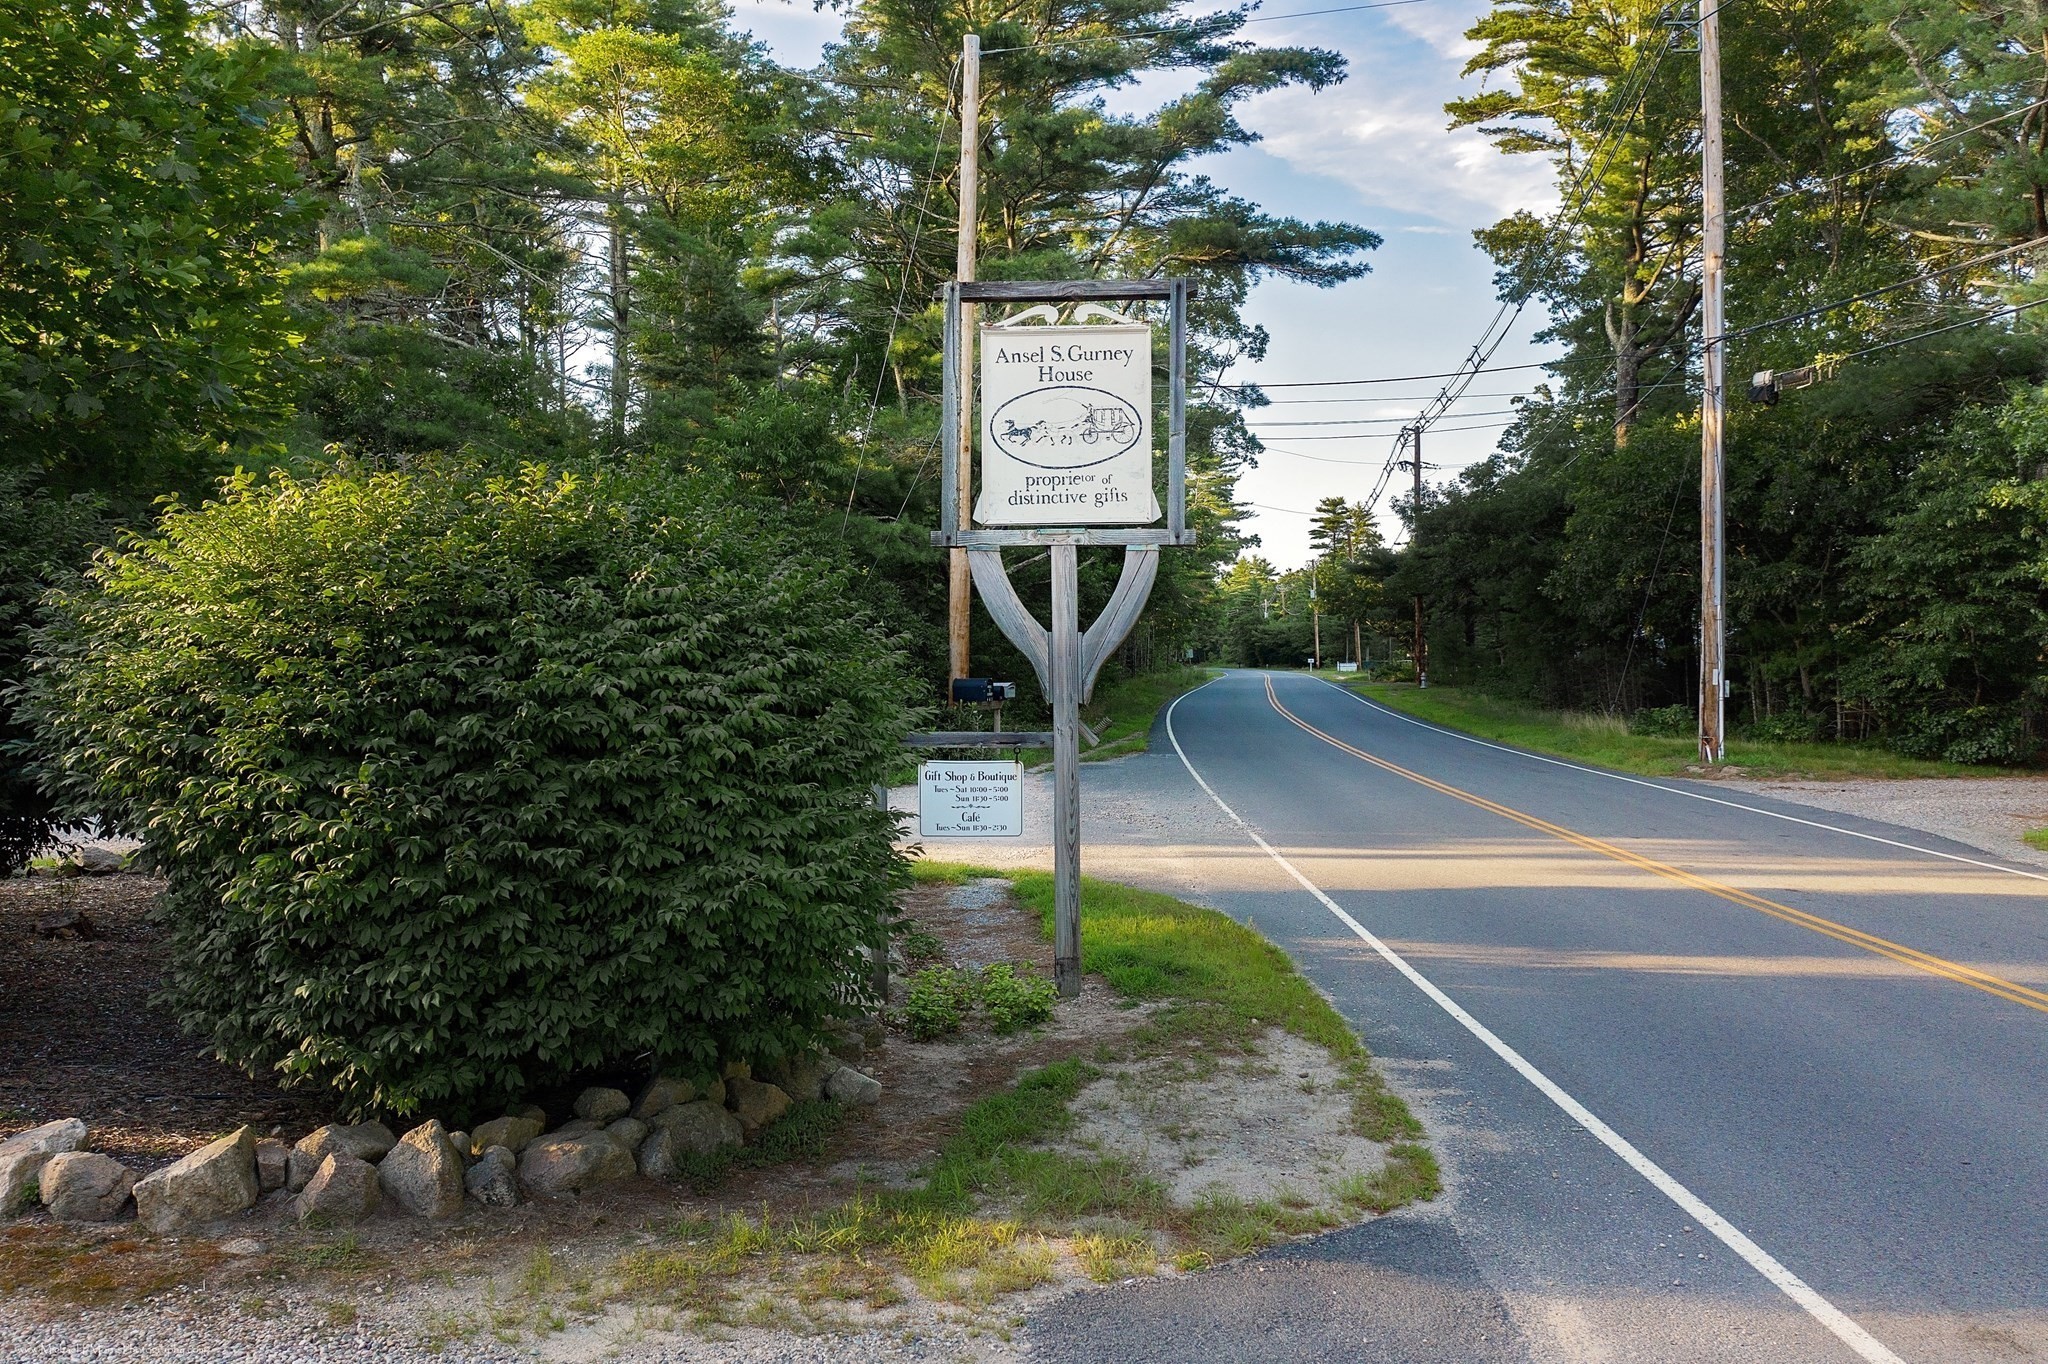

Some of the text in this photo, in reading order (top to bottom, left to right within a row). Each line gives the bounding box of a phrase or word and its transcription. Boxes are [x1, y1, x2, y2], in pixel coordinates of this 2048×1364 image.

[995, 346, 1044, 364] Ansel
[1038, 365, 1093, 382] House
[1025, 471, 1113, 492] proprietor of
[1008, 487, 1128, 508] distinctive gifts
[924, 770, 1018, 784] Gift Shop & Boutique
[955, 794, 970, 802] Sun
[961, 811, 980, 823] Café
